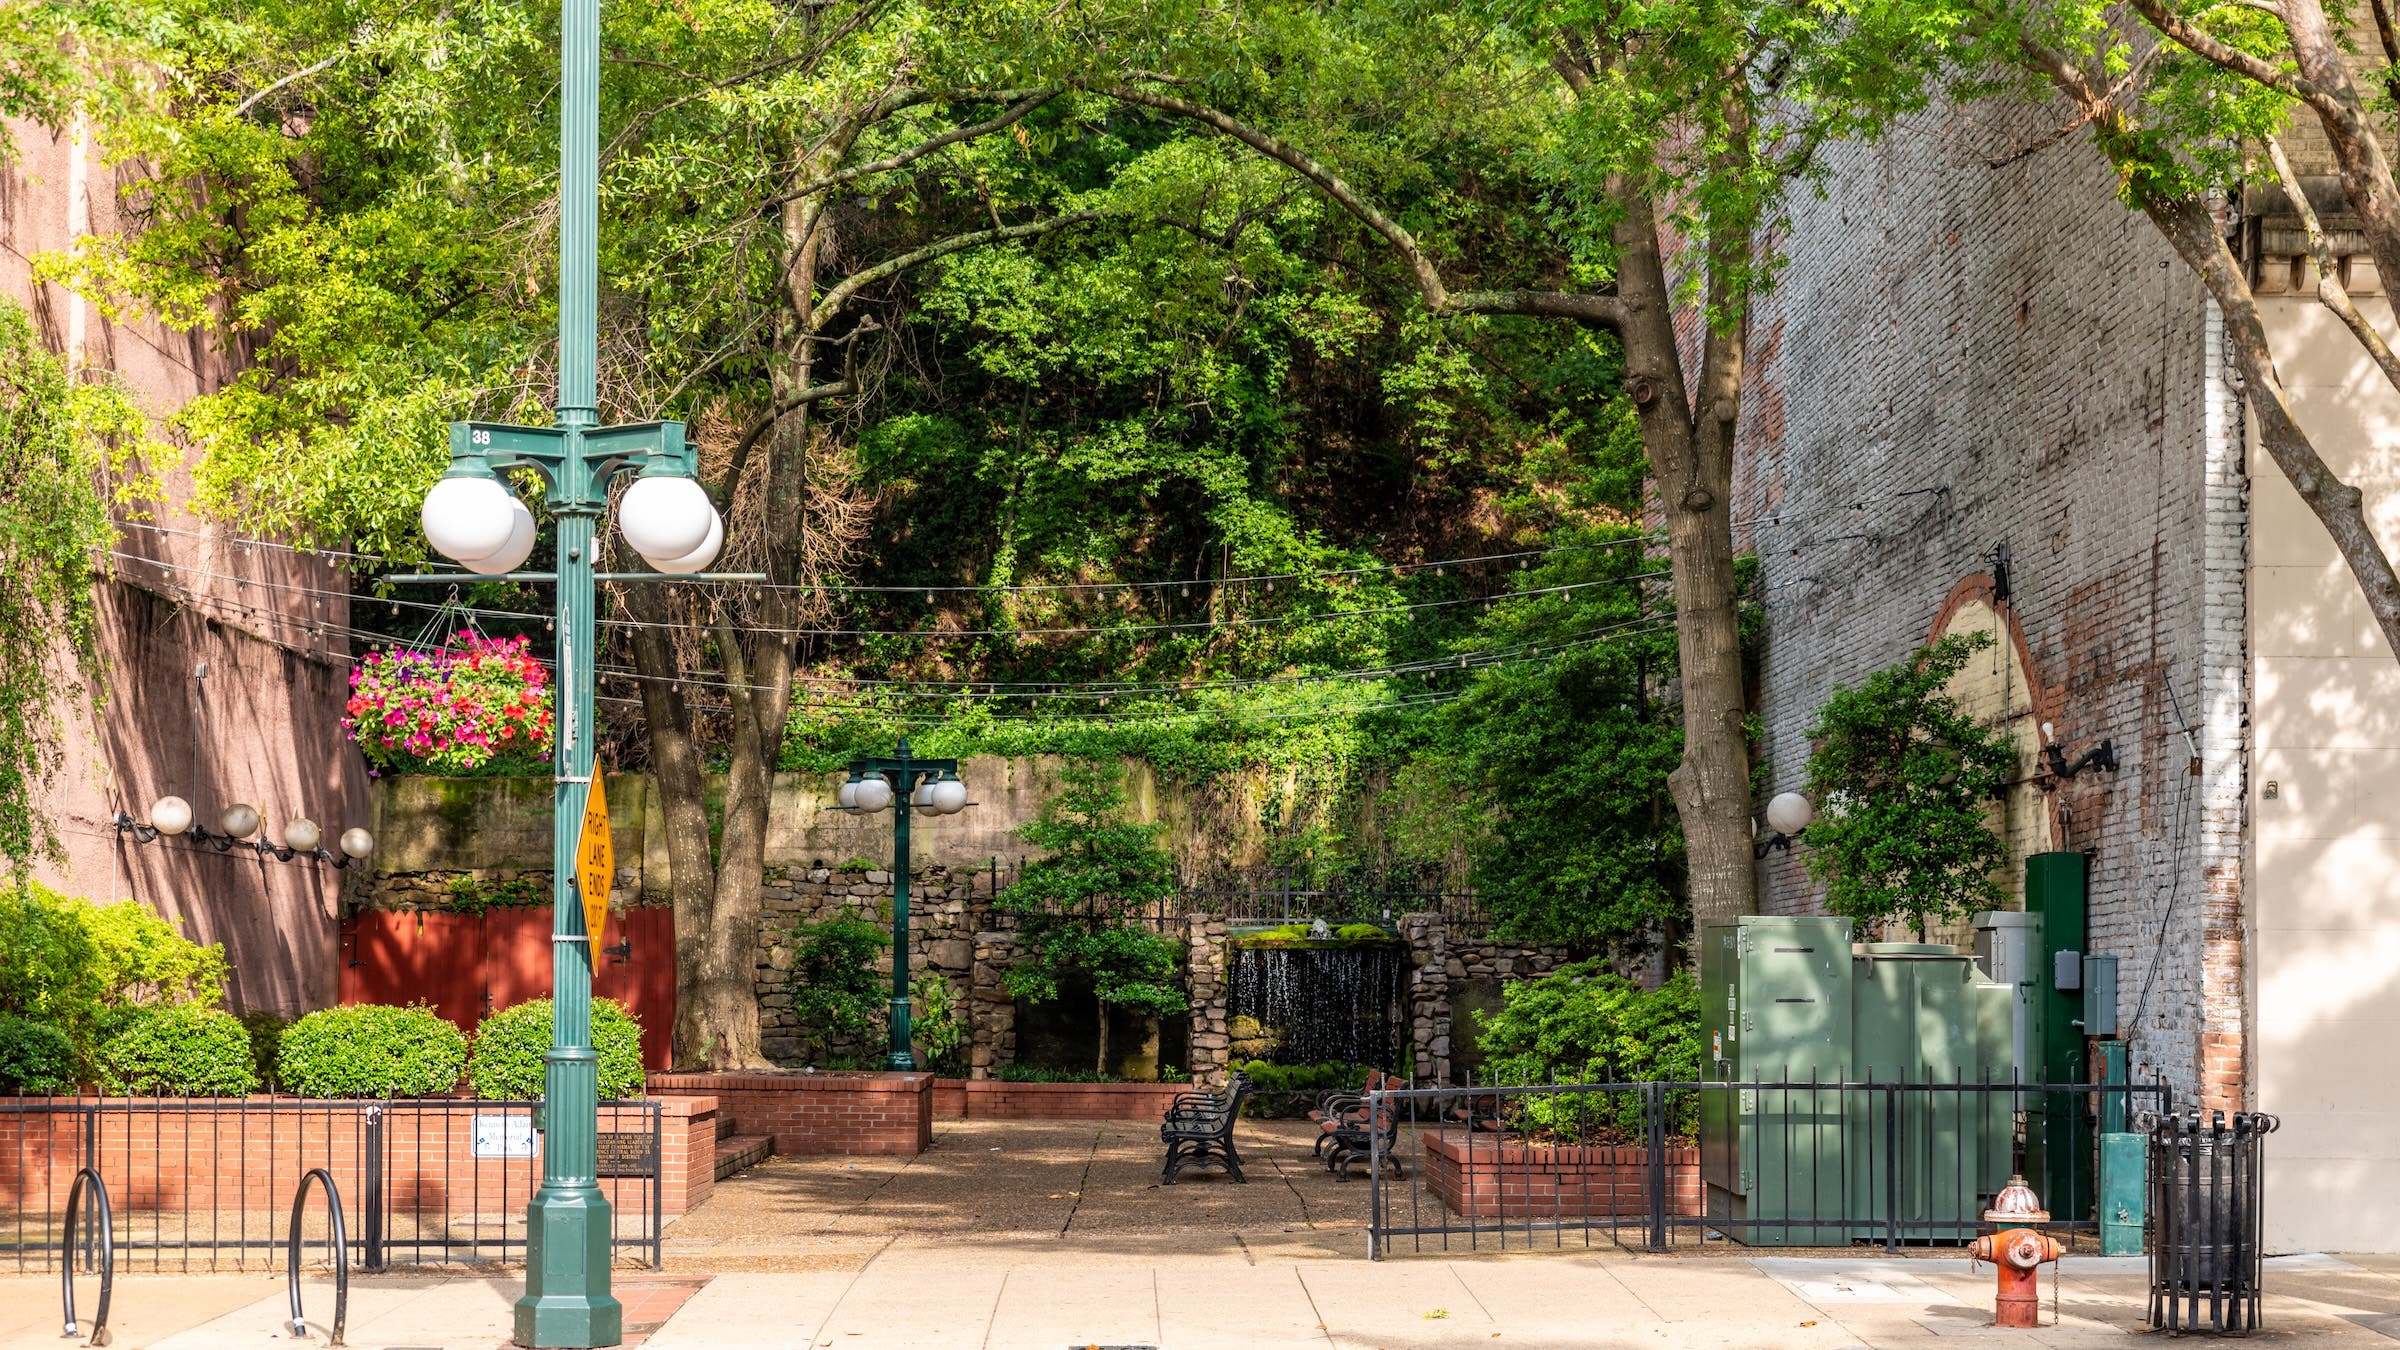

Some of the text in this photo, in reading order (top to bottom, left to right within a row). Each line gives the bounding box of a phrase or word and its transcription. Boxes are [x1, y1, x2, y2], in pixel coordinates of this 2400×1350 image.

[472, 429, 491, 445] 38
[588, 811, 606, 838] RIGHT
[588, 840, 605, 867] LANE
[589, 872, 604, 898] ENDS
[488, 1131, 522, 1140] Memrial
[497, 1143, 512, 1151] Pak
